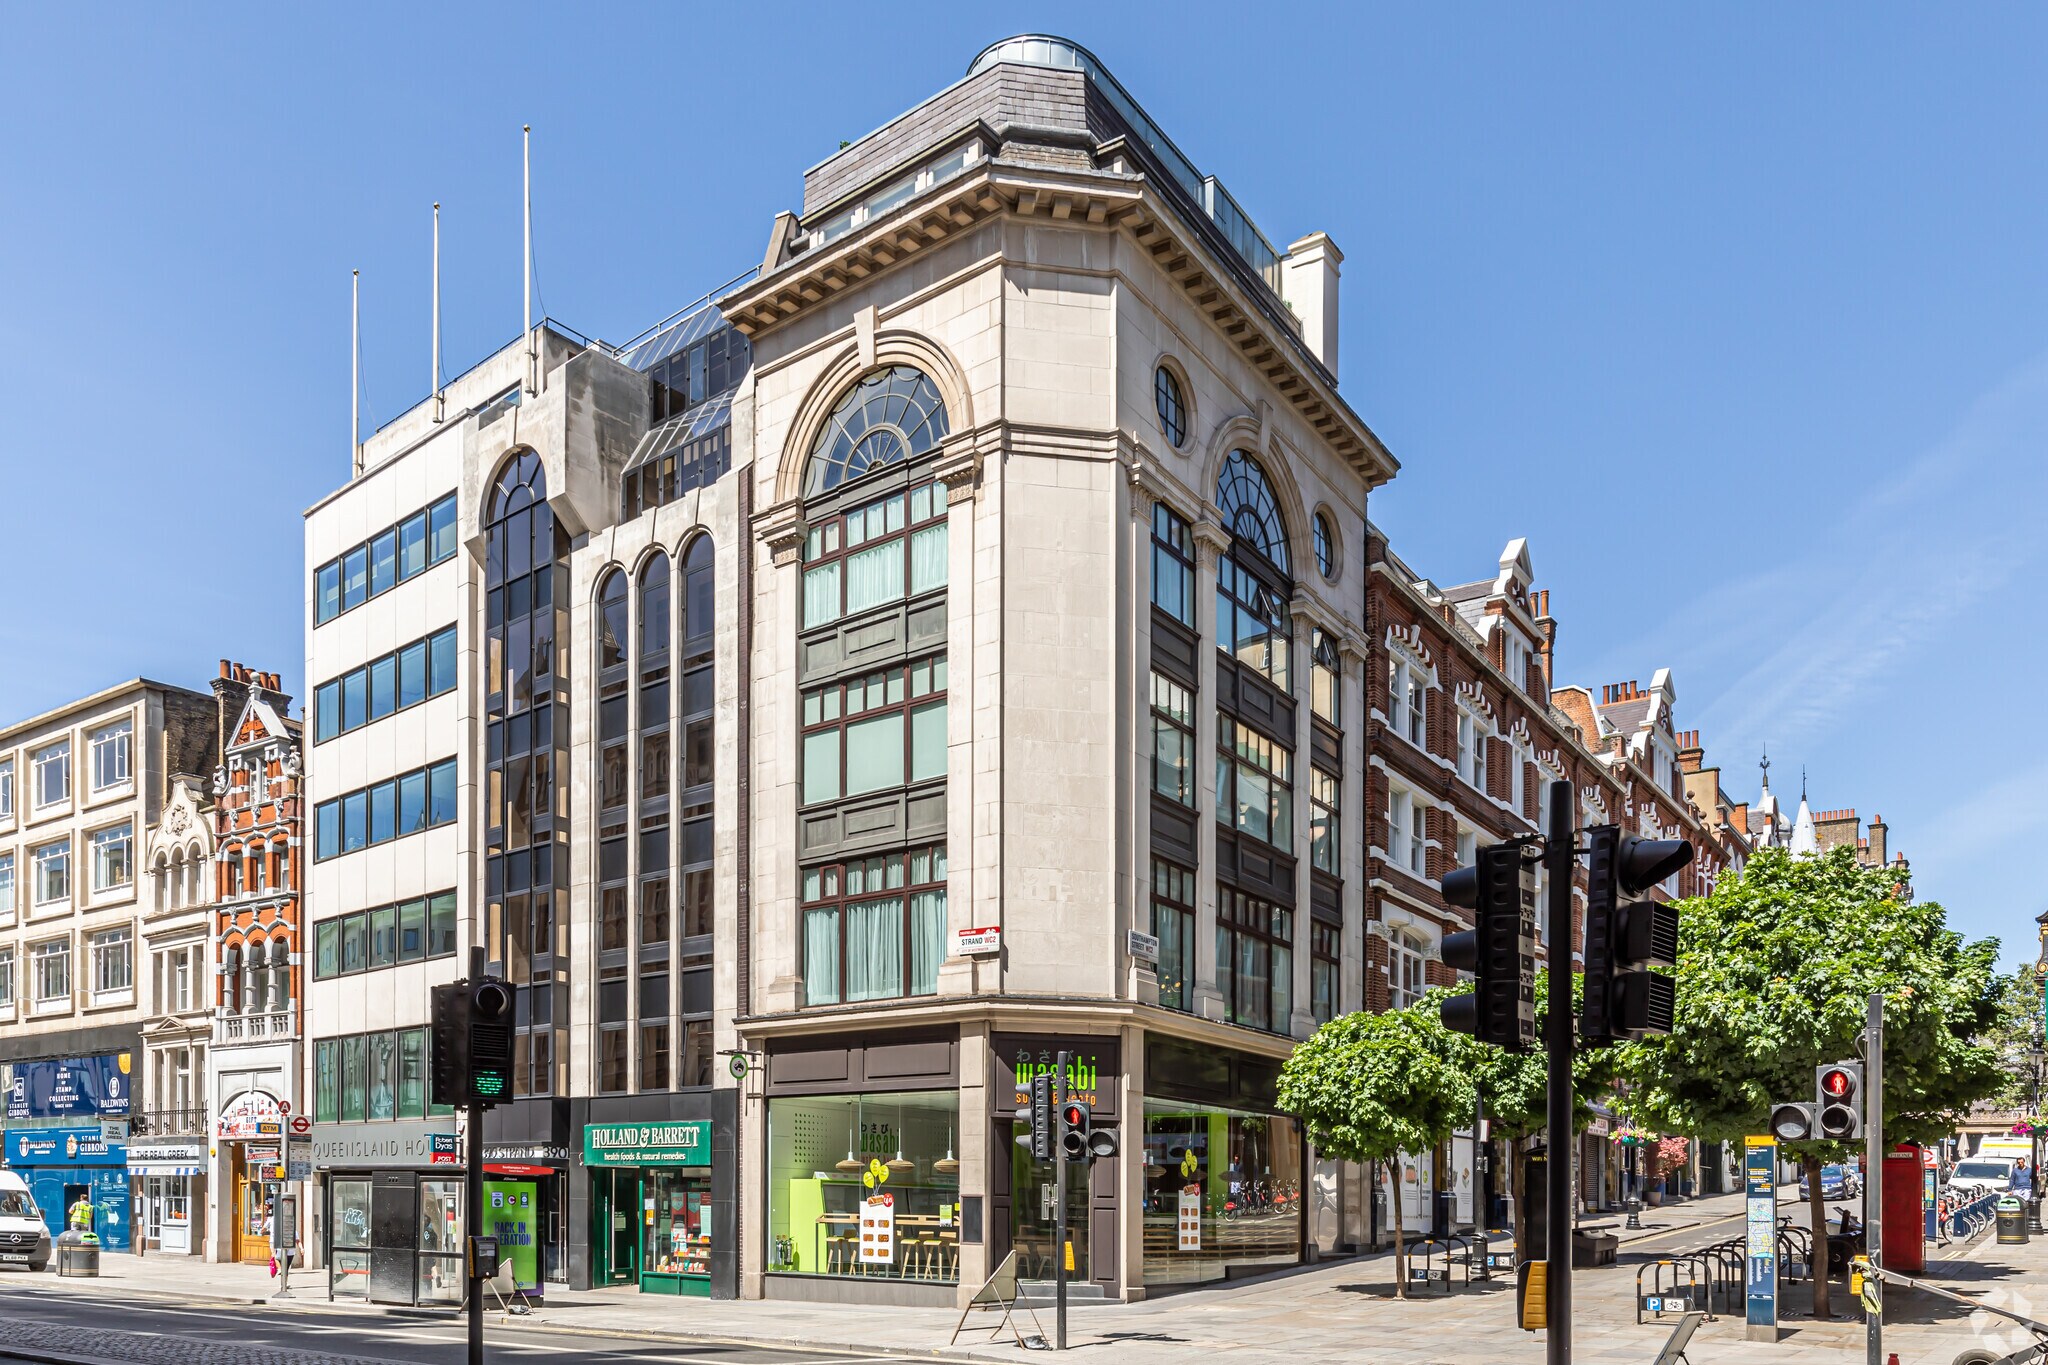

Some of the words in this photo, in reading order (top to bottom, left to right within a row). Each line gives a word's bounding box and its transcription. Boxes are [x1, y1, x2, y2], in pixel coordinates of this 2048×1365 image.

[961, 937, 983, 946] STRAND
[983, 935, 996, 944] WC2
[1131, 932, 1158, 947] SOUTHAMPTON
[1131, 940, 1144, 950] STREET
[281, 1102, 288, 1111] A
[8, 1109, 30, 1117] GIBBONS
[592, 1127, 638, 1149] HOLLAND
[640, 1127, 650, 1148] &
[651, 1126, 700, 1148] BARRETT
[80, 1142, 108, 1152] GIBBONS
[313, 1140, 399, 1160] QUEENSLAND
[435, 1142, 453, 1150] Dyas
[136, 1150, 148, 1160] THE
[150, 1150, 166, 1160] REAL
[168, 1150, 189, 1160] GREEK
[542, 1146, 567, 1158] 390
[604, 1152, 620, 1160] health
[620, 1152, 635, 1162] foods
[642, 1152, 660, 1160] natural
[661, 1152, 686, 1160] remedies
[494, 1222, 514, 1234] BACK
[518, 1221, 526, 1233] IN
[1650, 1298, 1659, 1310] P
